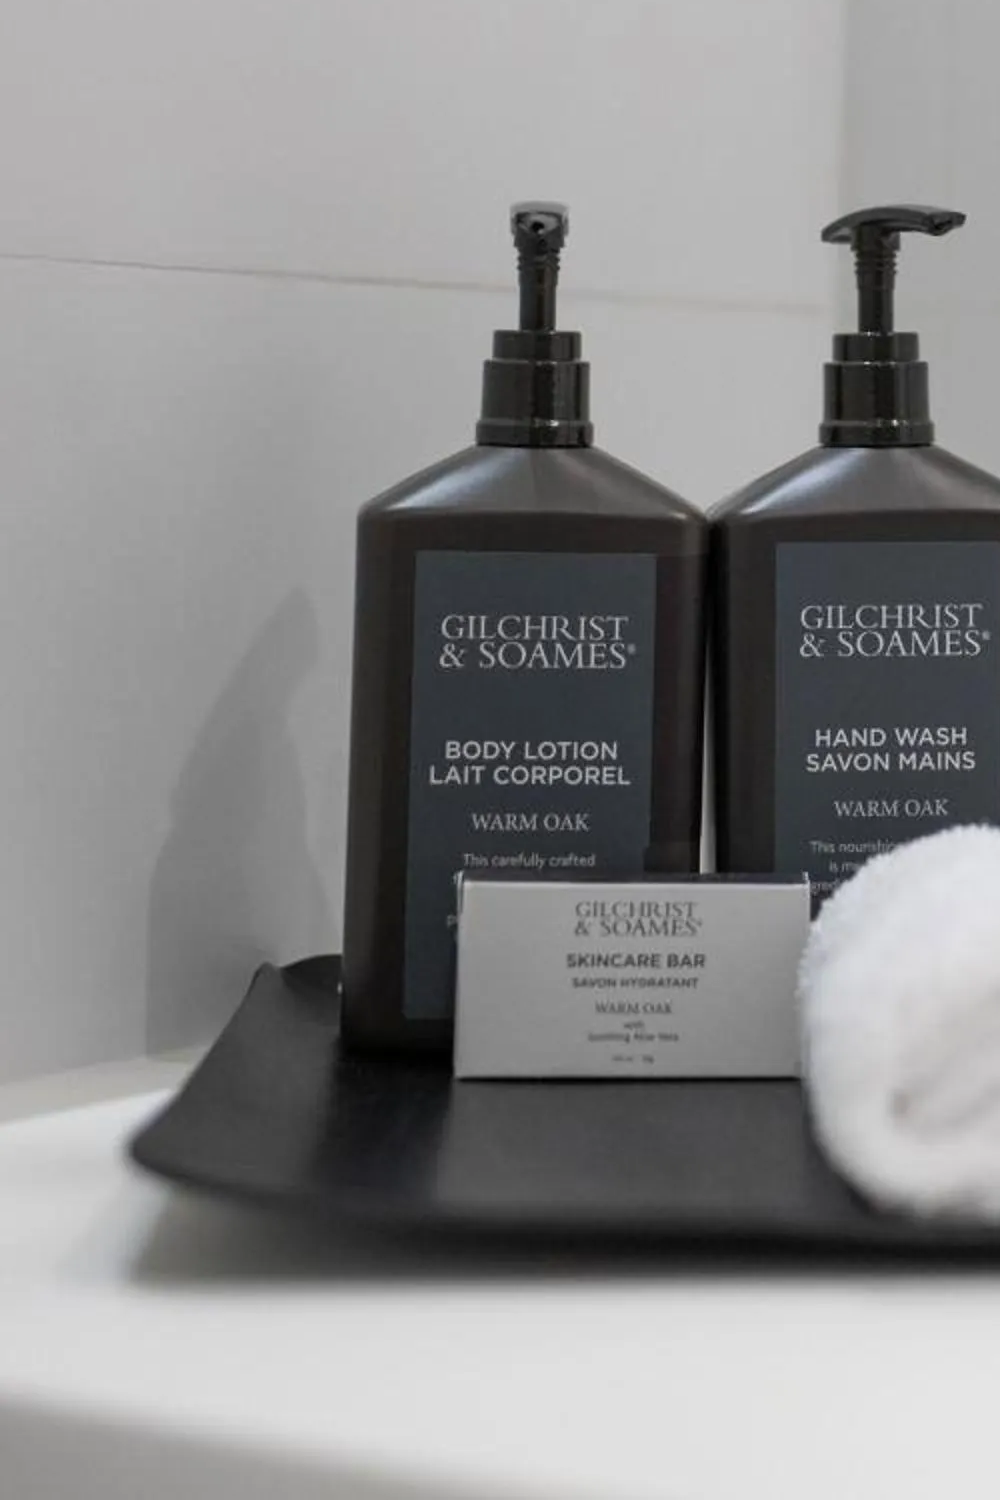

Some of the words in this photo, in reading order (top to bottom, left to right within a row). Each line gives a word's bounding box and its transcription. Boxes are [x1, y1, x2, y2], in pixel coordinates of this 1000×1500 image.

[801, 604, 984, 630] GILCHRIST
[440, 615, 629, 641] GILCHRIST
[799, 633, 824, 657] &
[439, 644, 465, 669] &
[814, 728, 886, 748] HAND
[893, 726, 968, 747] WASH
[445, 741, 516, 760] BODY
[525, 741, 618, 761] LOTION
[805, 752, 890, 773] SAVON
[898, 750, 976, 771] MAINS
[429, 765, 485, 785] LAIT
[493, 765, 630, 786] CORPOREL
[833, 800, 897, 818] WARM
[904, 799, 949, 817] OAK
[471, 813, 538, 831] WARM
[543, 813, 590, 831] OAK
[463, 852, 489, 867] This
[491, 851, 546, 871] carefully
[548, 852, 596, 868] crafted
[575, 901, 697, 918] GILCHRIST
[566, 953, 661, 969] SKINCARE
[667, 953, 706, 968] BAR
[572, 976, 617, 989] SAVON
[620, 976, 699, 990] HYDRATANT
